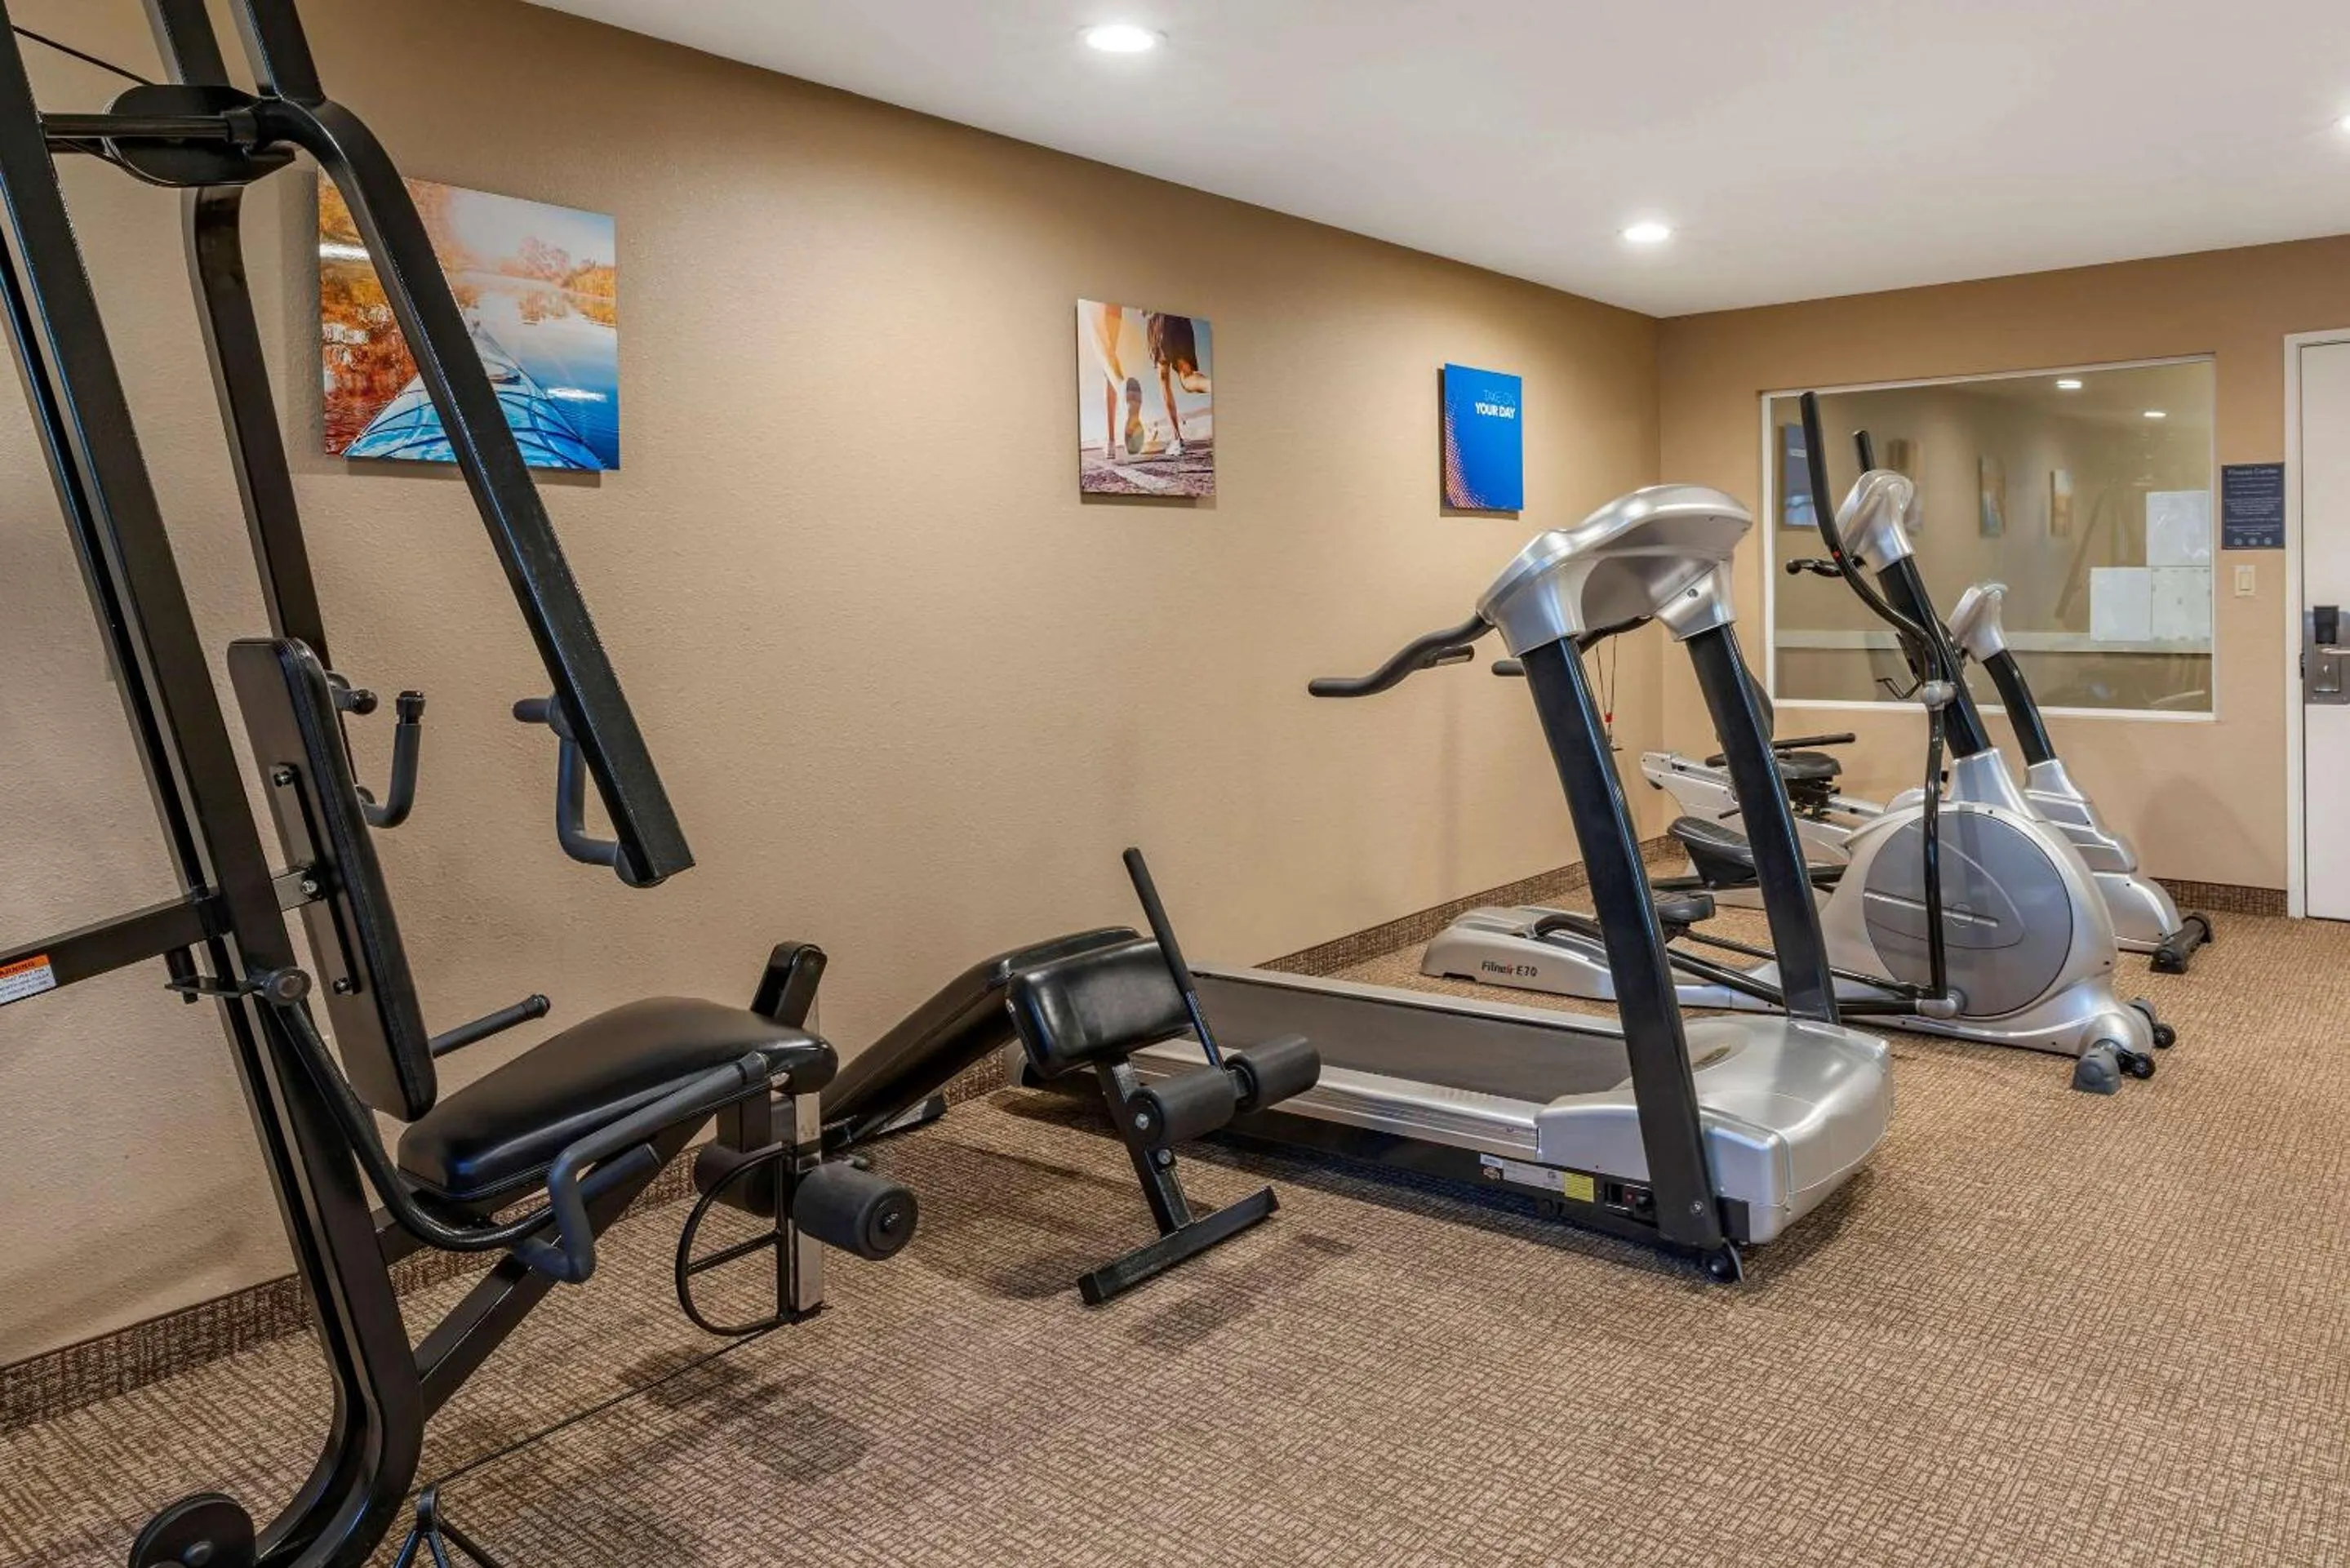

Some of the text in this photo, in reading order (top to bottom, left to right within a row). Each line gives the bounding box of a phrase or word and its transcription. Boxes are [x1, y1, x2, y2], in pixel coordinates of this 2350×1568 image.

[1476, 402, 1516, 419] YOUR DAY
[1516, 965, 1538, 977] E70
